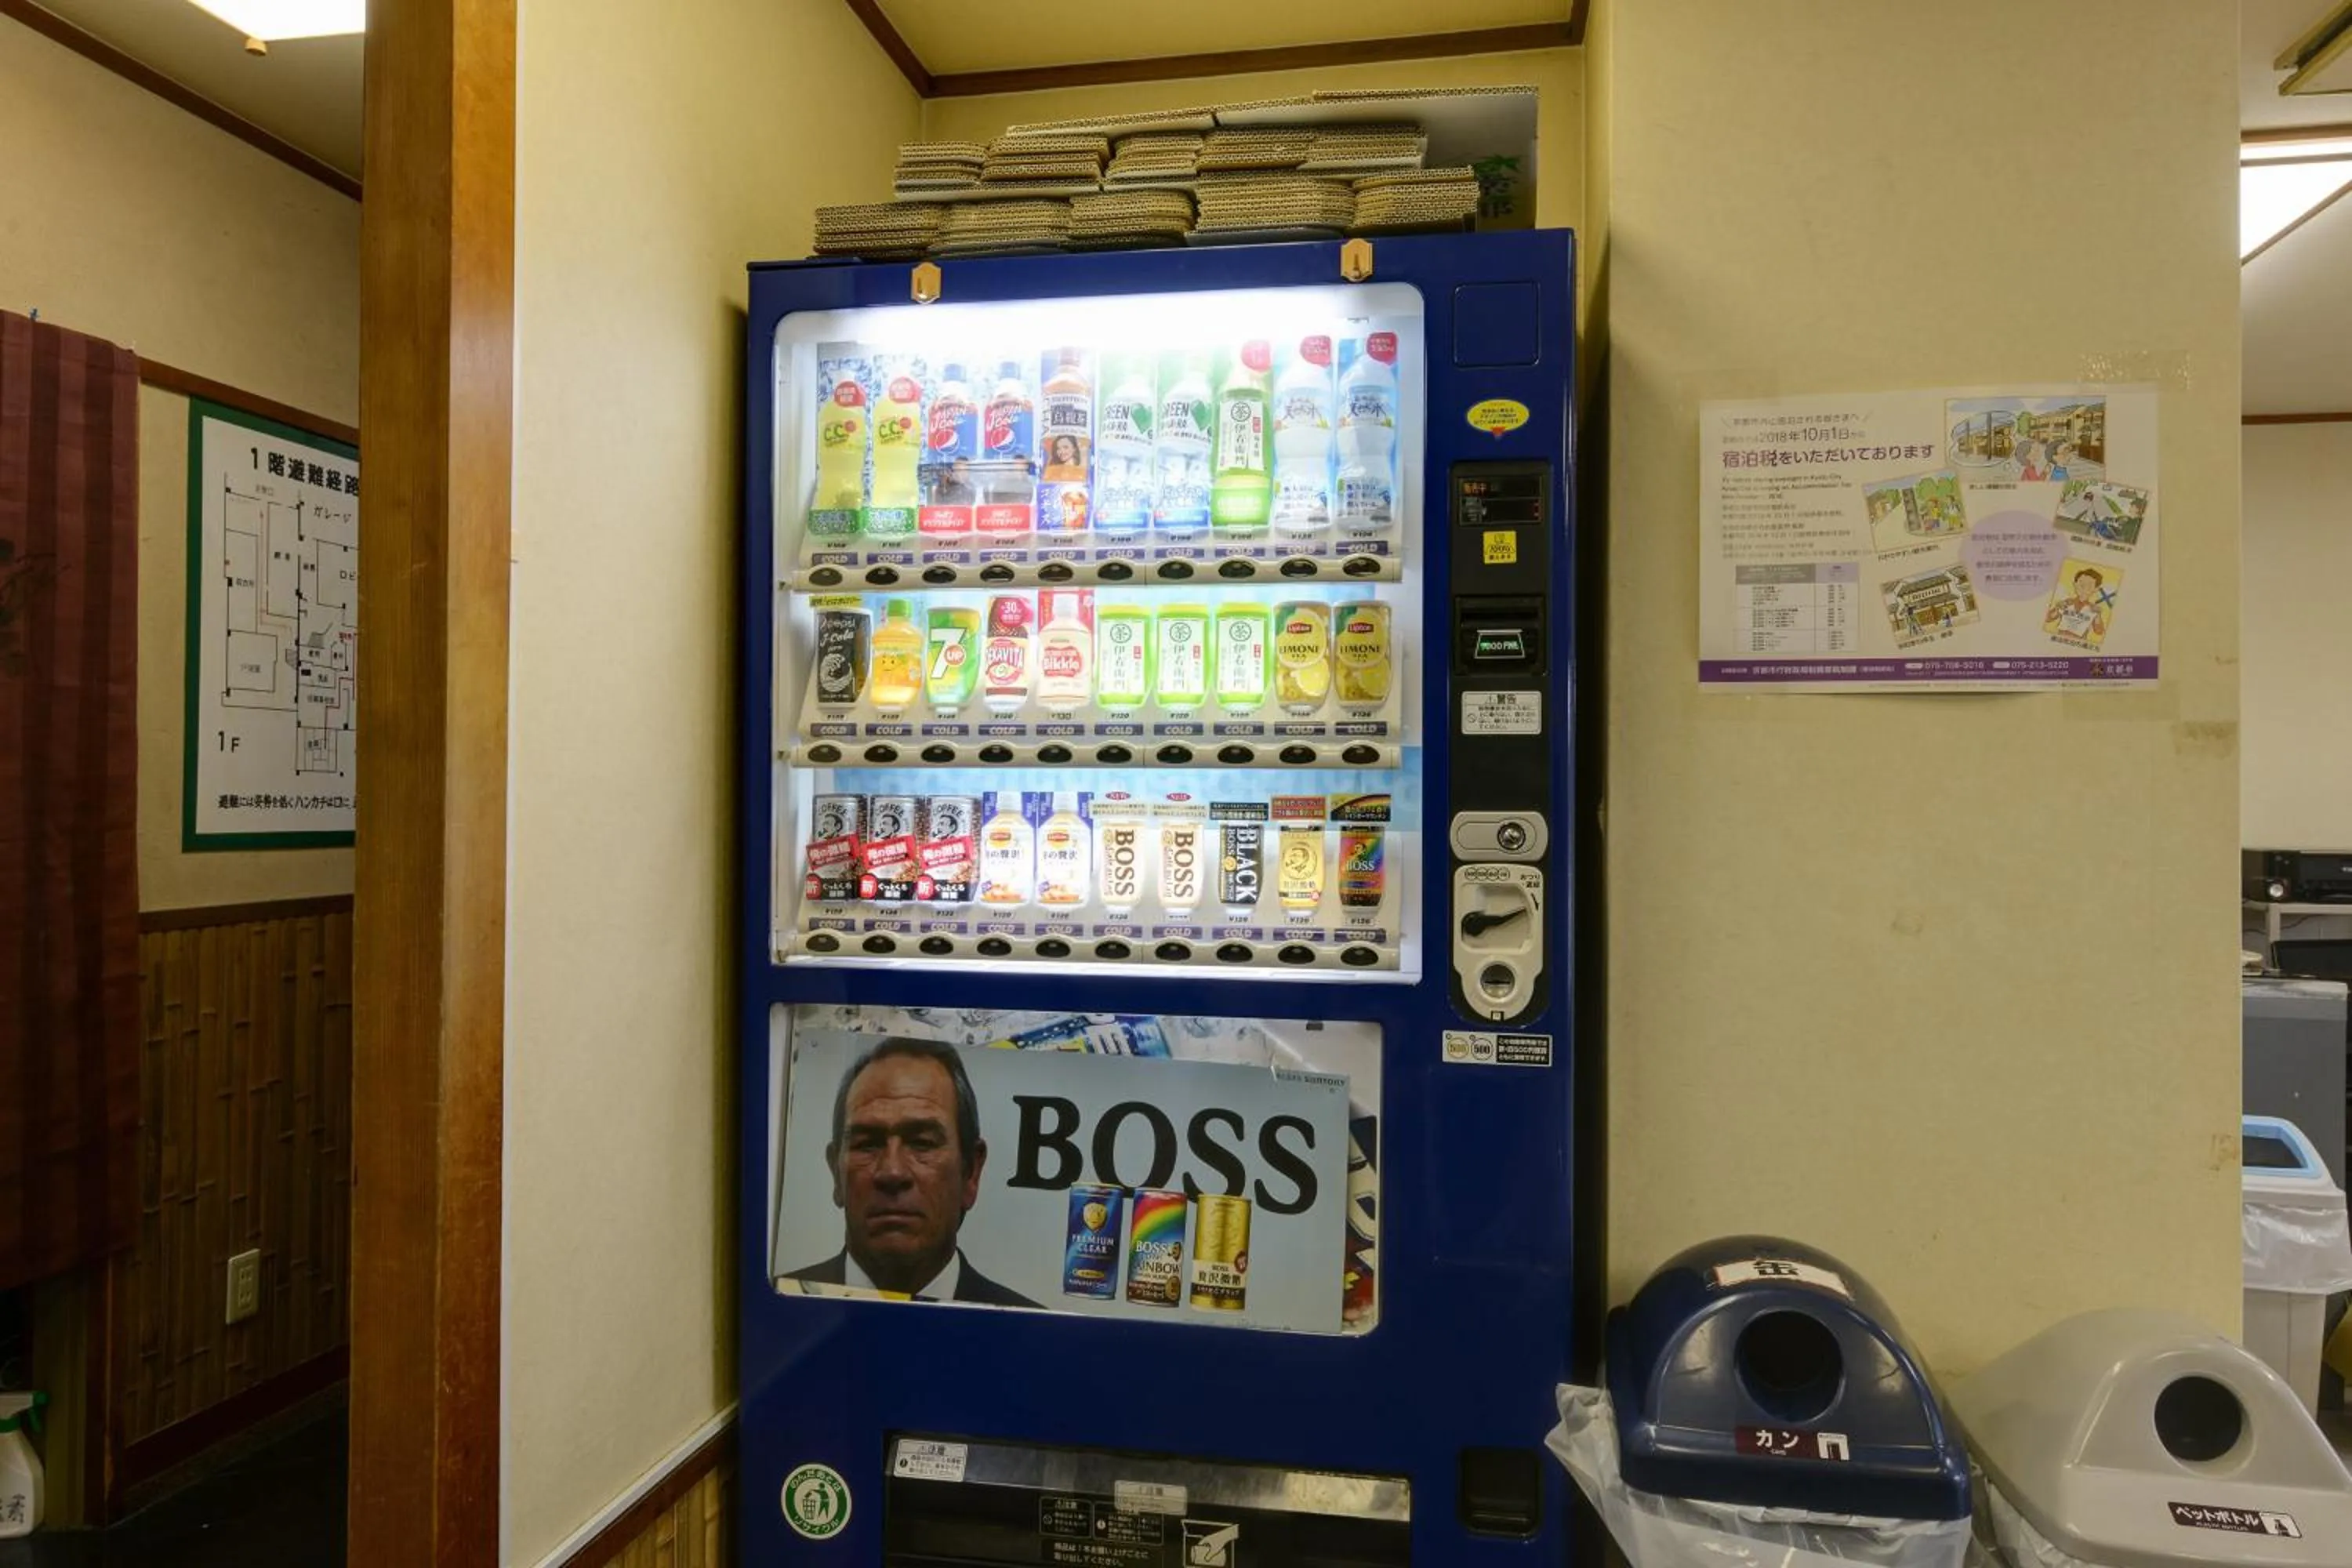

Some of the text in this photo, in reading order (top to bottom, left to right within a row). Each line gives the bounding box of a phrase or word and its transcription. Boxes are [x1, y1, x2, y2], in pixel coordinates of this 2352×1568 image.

[1722, 444, 1934, 469] 宿泊税をいただいております
[1287, 545, 1316, 554] COLD
[1348, 543, 1377, 552] COLD
[820, 726, 847, 735] COLD
[876, 726, 902, 735] COLD
[1114, 829, 1134, 896] BOSS
[1174, 830, 1194, 898] BOSS
[1236, 825, 1257, 902] BLACK
[1346, 859, 1375, 871] BOSS
[874, 921, 901, 930] COLD
[1104, 927, 1132, 935] COLD
[1163, 927, 1192, 936] COLD
[1224, 928, 1252, 937] COLD
[1285, 931, 1313, 939] COLD
[1347, 931, 1376, 939] COLD
[1007, 1094, 1317, 1215] BOSS
[1071, 1234, 1114, 1247] PREMIUM
[1078, 1243, 1108, 1254] CLEAR
[1135, 1240, 1167, 1253] BOSS
[1755, 1429, 1799, 1449] カン
[2176, 1506, 2259, 1526] ペットボトル
